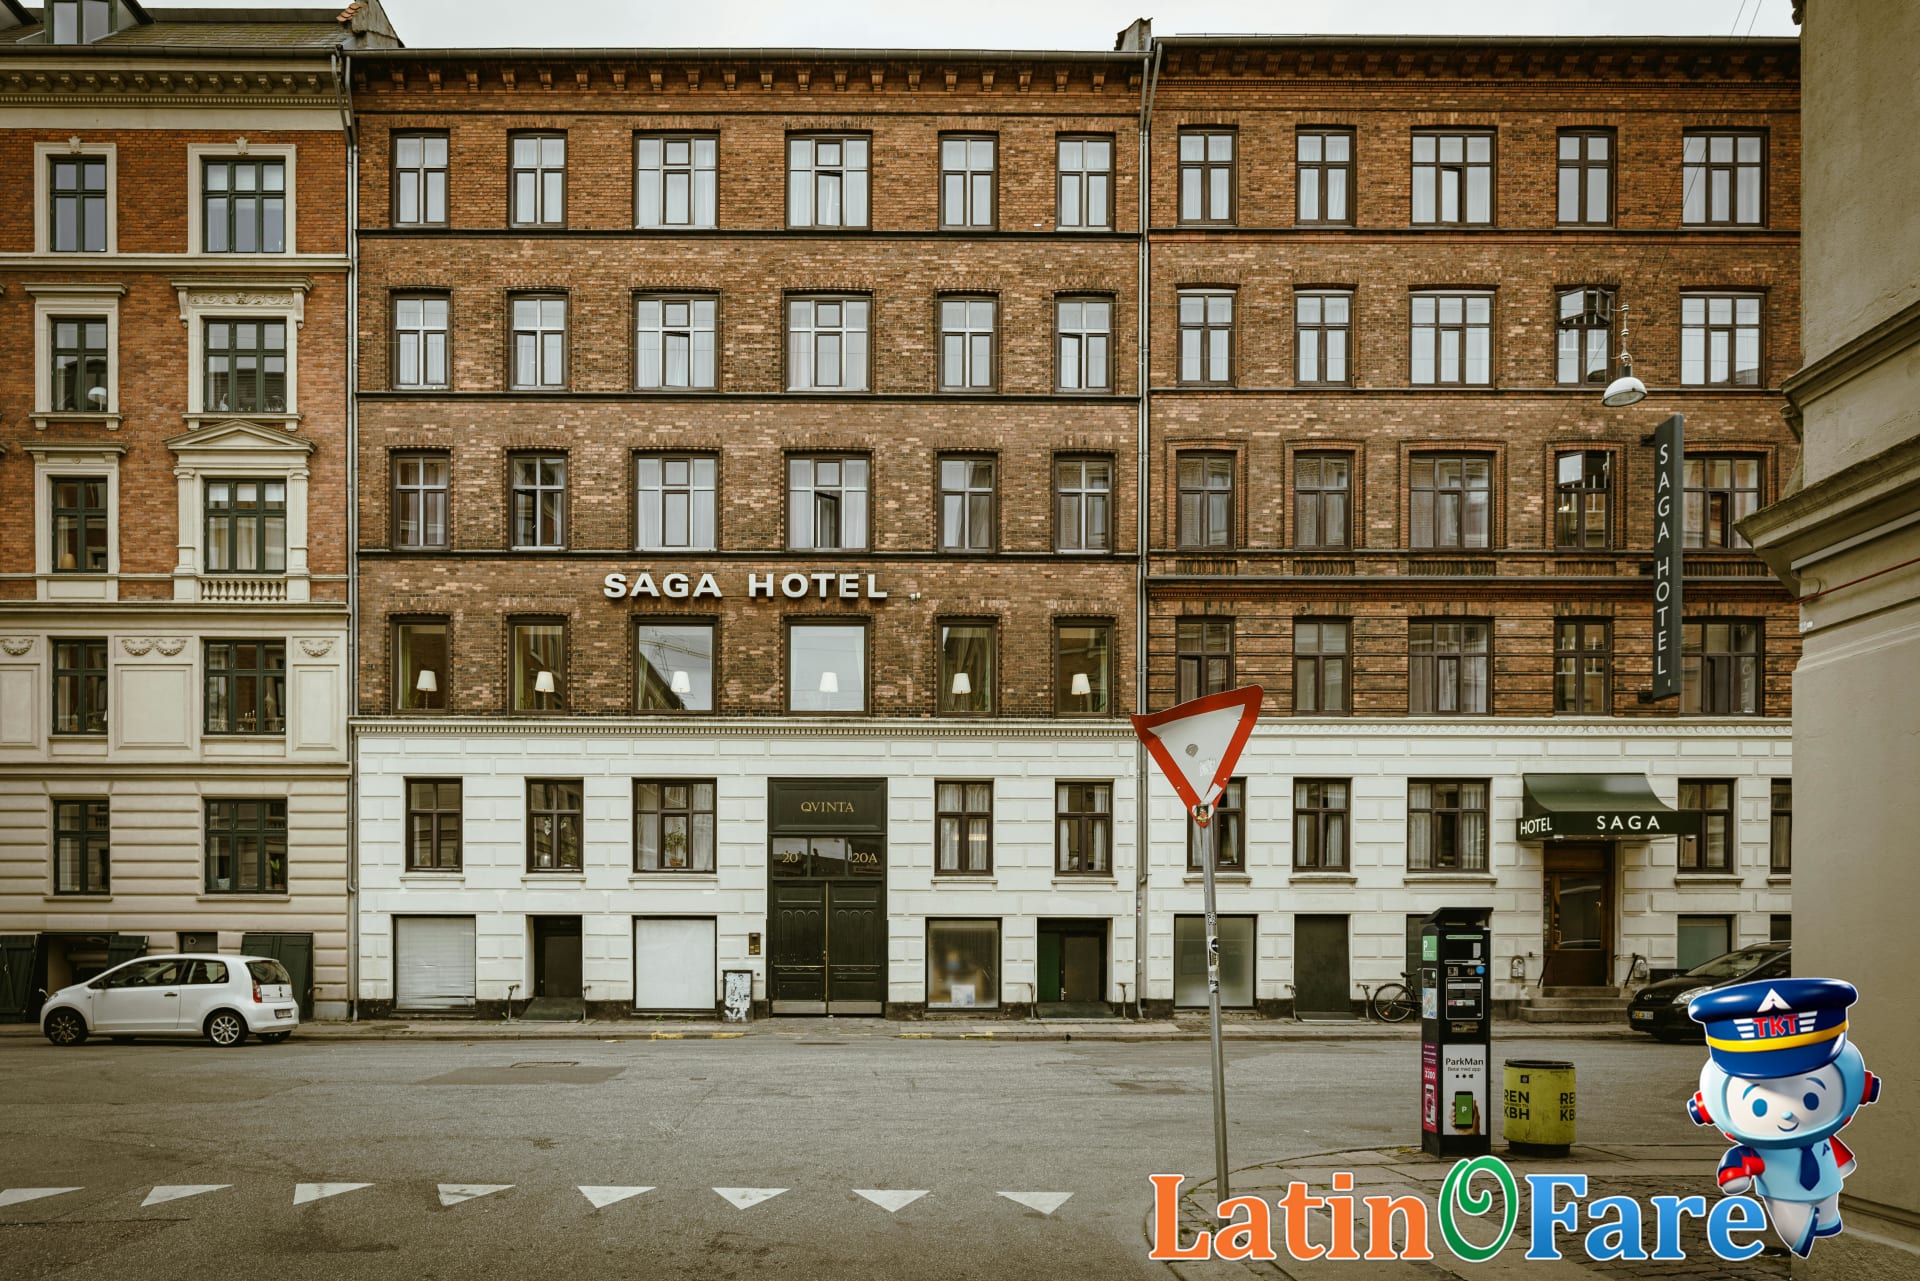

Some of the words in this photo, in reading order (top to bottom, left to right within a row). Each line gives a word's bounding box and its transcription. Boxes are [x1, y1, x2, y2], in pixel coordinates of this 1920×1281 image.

[1657, 443, 1670, 544] SAGA
[603, 573, 723, 598] SAGA
[749, 573, 888, 598] HOTEL
[1656, 556, 1670, 675] HOTEL
[800, 801, 855, 813] QVINTA
[1520, 817, 1553, 835] HOTEL
[1596, 815, 1661, 830] SAGA
[782, 852, 799, 864] 20
[852, 852, 878, 864] 20A
[1423, 940, 1429, 951] P
[1445, 1057, 1484, 1066] ParkMan
[1504, 1089, 1530, 1103] REN
[1504, 1106, 1530, 1120] KBH
